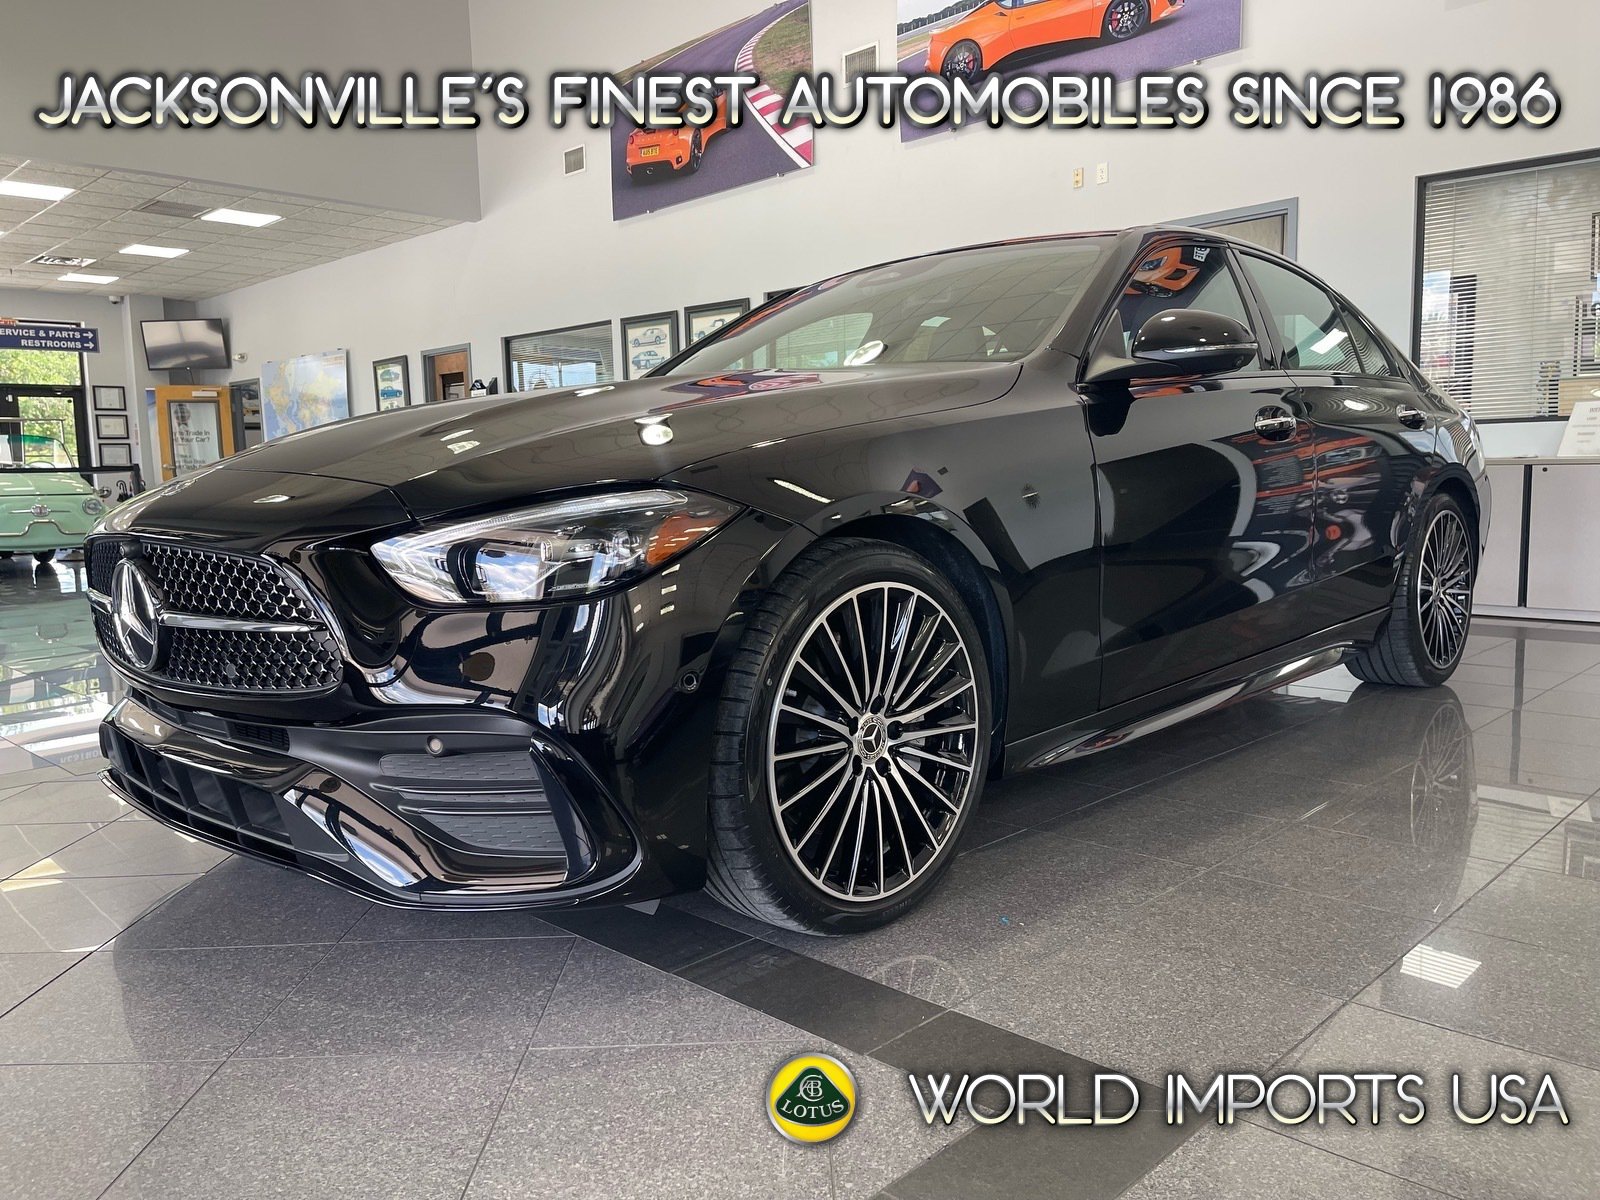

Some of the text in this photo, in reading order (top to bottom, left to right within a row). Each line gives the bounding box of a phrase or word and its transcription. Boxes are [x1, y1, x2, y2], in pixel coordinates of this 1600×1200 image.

[0, 328, 36, 336] ERVICE
[49, 331, 81, 339] PARTS
[21, 339, 81, 349] RESTROOMS
